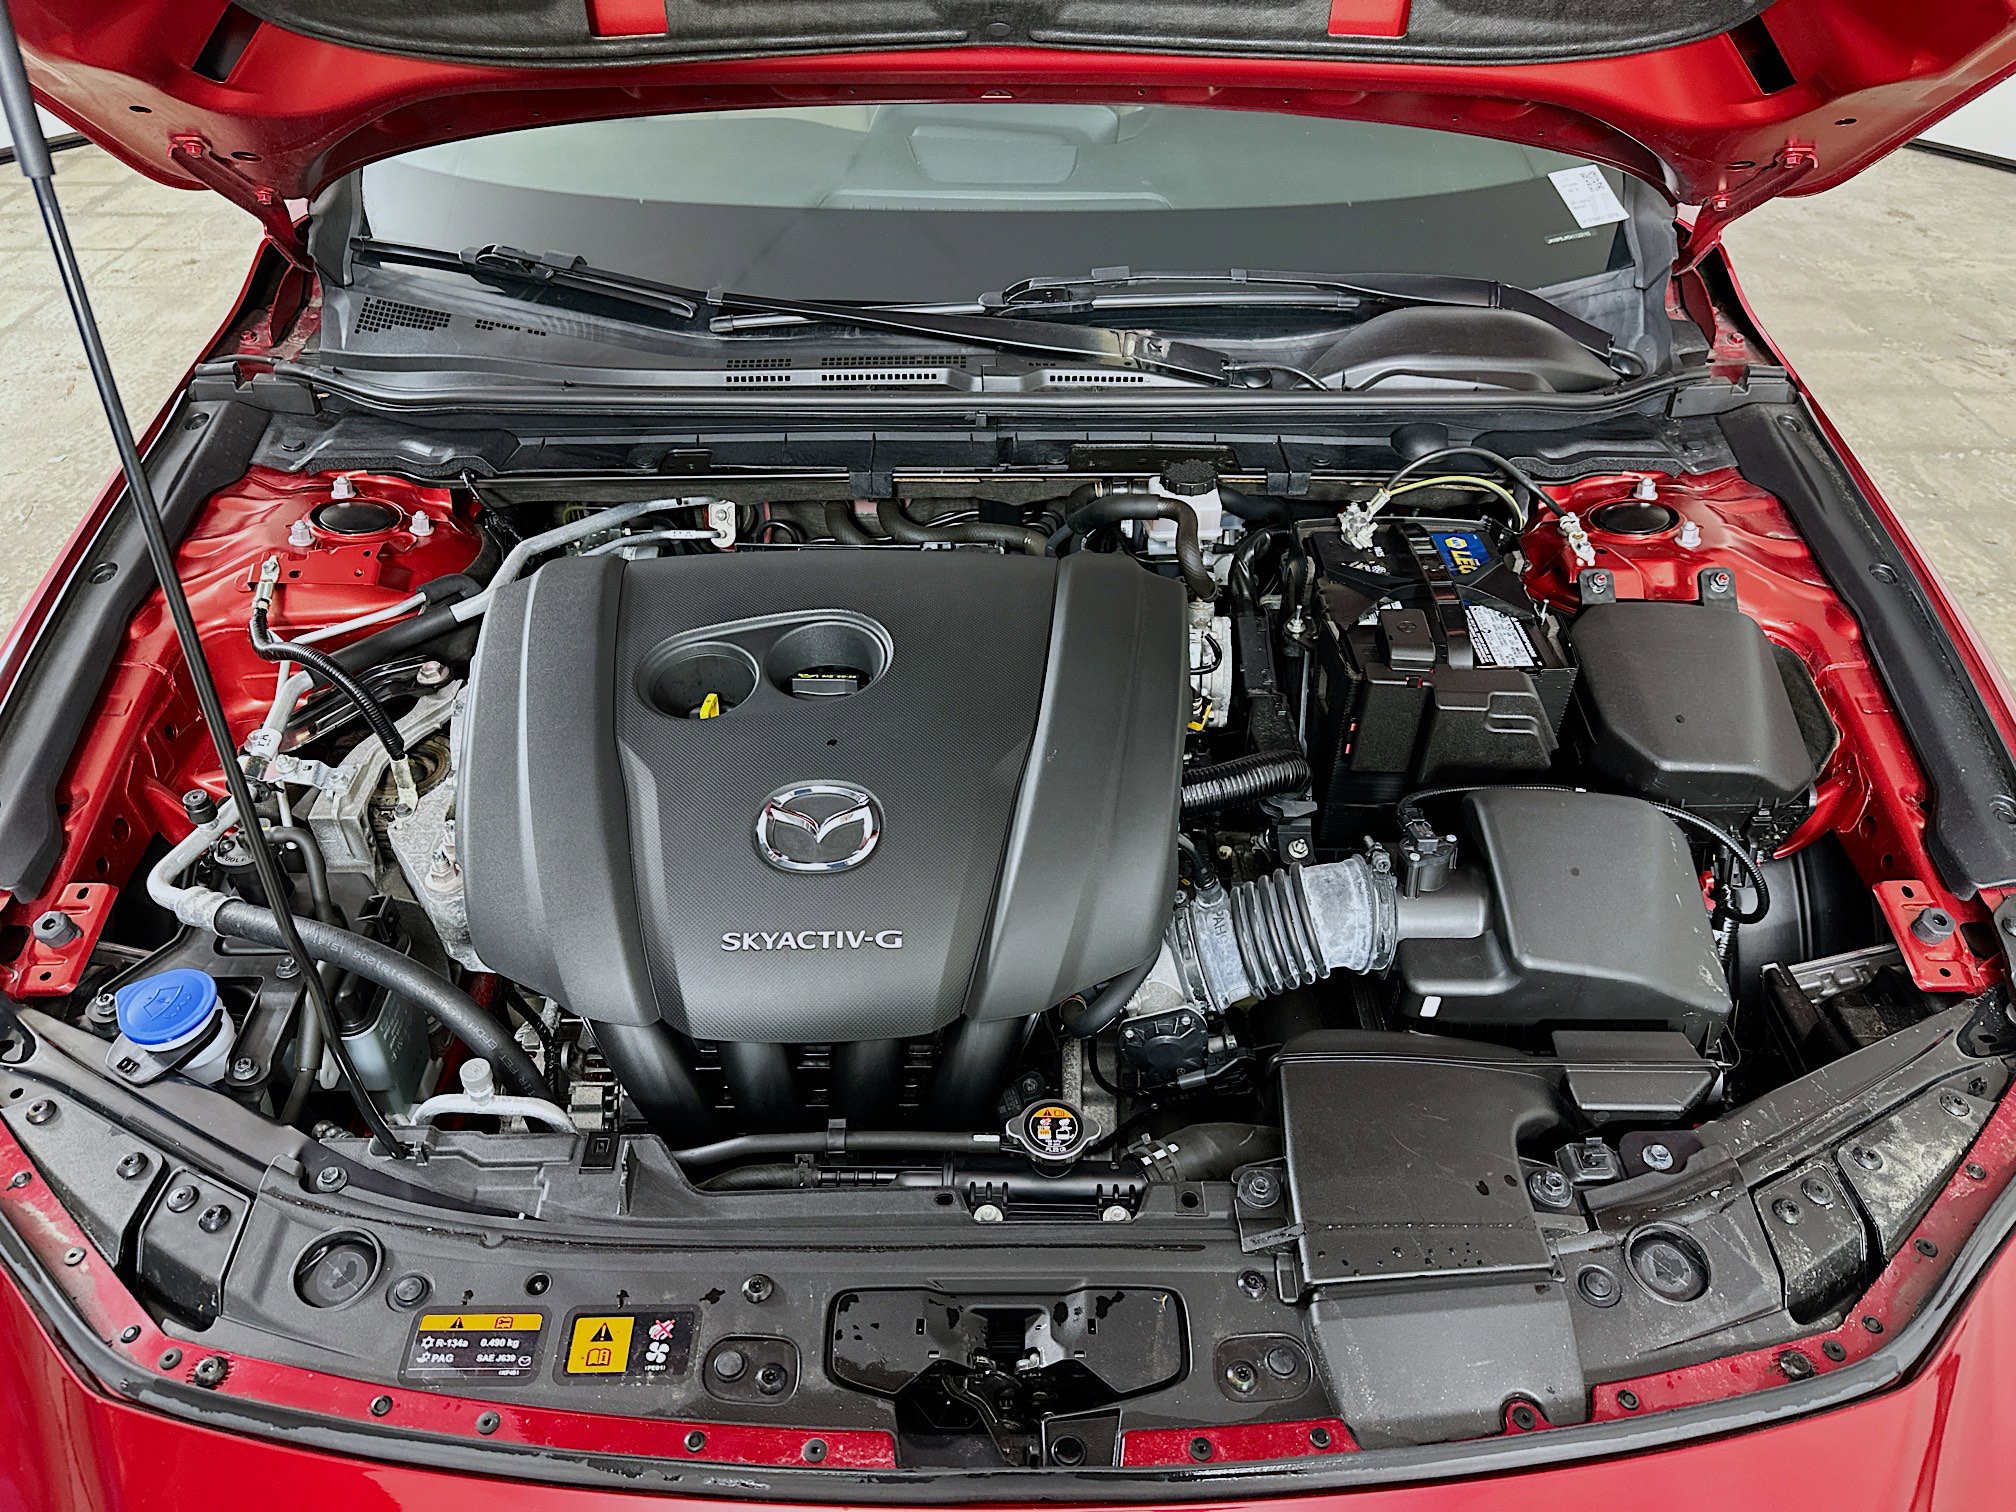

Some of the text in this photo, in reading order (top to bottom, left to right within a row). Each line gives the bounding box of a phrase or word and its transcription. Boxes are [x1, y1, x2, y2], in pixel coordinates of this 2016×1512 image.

[721, 930, 903, 951] SKYACTIV-G
[468, 1022, 498, 1050] EPDM
[499, 1054, 519, 1075] PET
[435, 1338, 469, 1348] R-134a
[506, 1338, 520, 1349] kg
[431, 1353, 454, 1363] PAG
[476, 1353, 496, 1363] SAE
